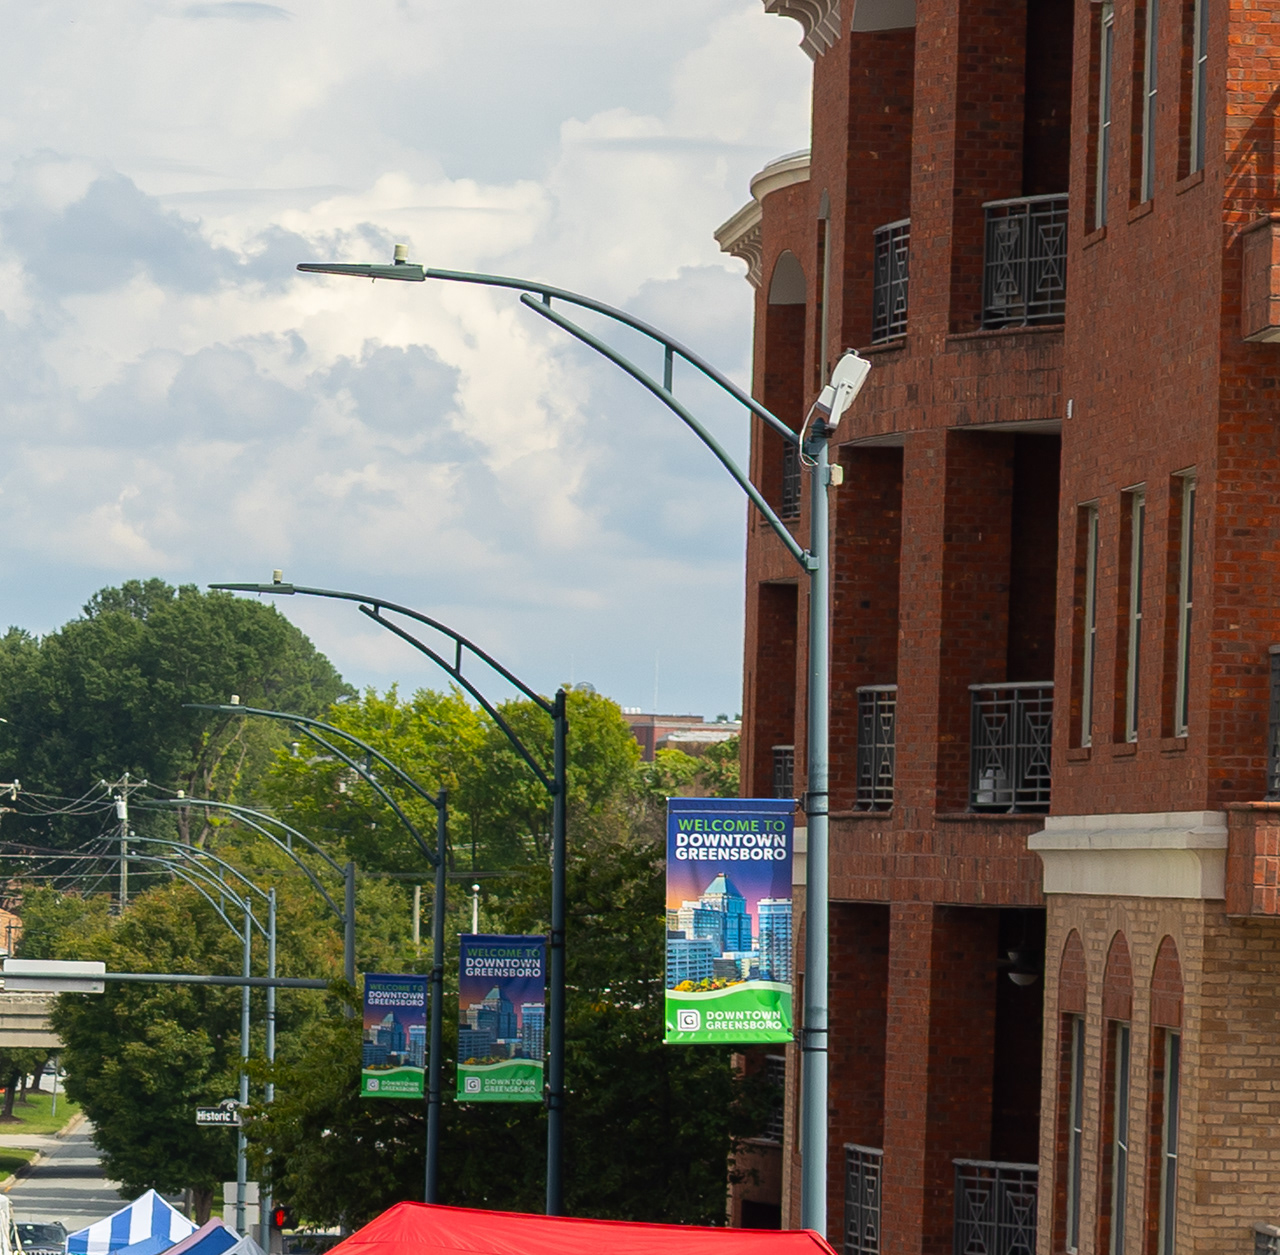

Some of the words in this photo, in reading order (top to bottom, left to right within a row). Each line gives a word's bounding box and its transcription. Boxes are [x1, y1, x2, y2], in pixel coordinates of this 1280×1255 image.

[678, 819, 759, 831] WELCOME
[764, 820, 786, 832] TO
[676, 833, 786, 847] DOWNTOWN
[675, 848, 787, 860] GREENSBORO
[467, 948, 522, 957] WELCOME
[526, 949, 540, 957] TO
[466, 958, 541, 967] DOWNTOWN
[465, 967, 541, 977] GREENSBORO
[368, 991, 424, 999] DOWNTOWN
[368, 998, 424, 1007] GREENSBORO
[706, 1011, 781, 1020] DOWNTOWN
[706, 1021, 782, 1030] GREENSBORO
[197, 1111, 231, 1121] Historic
